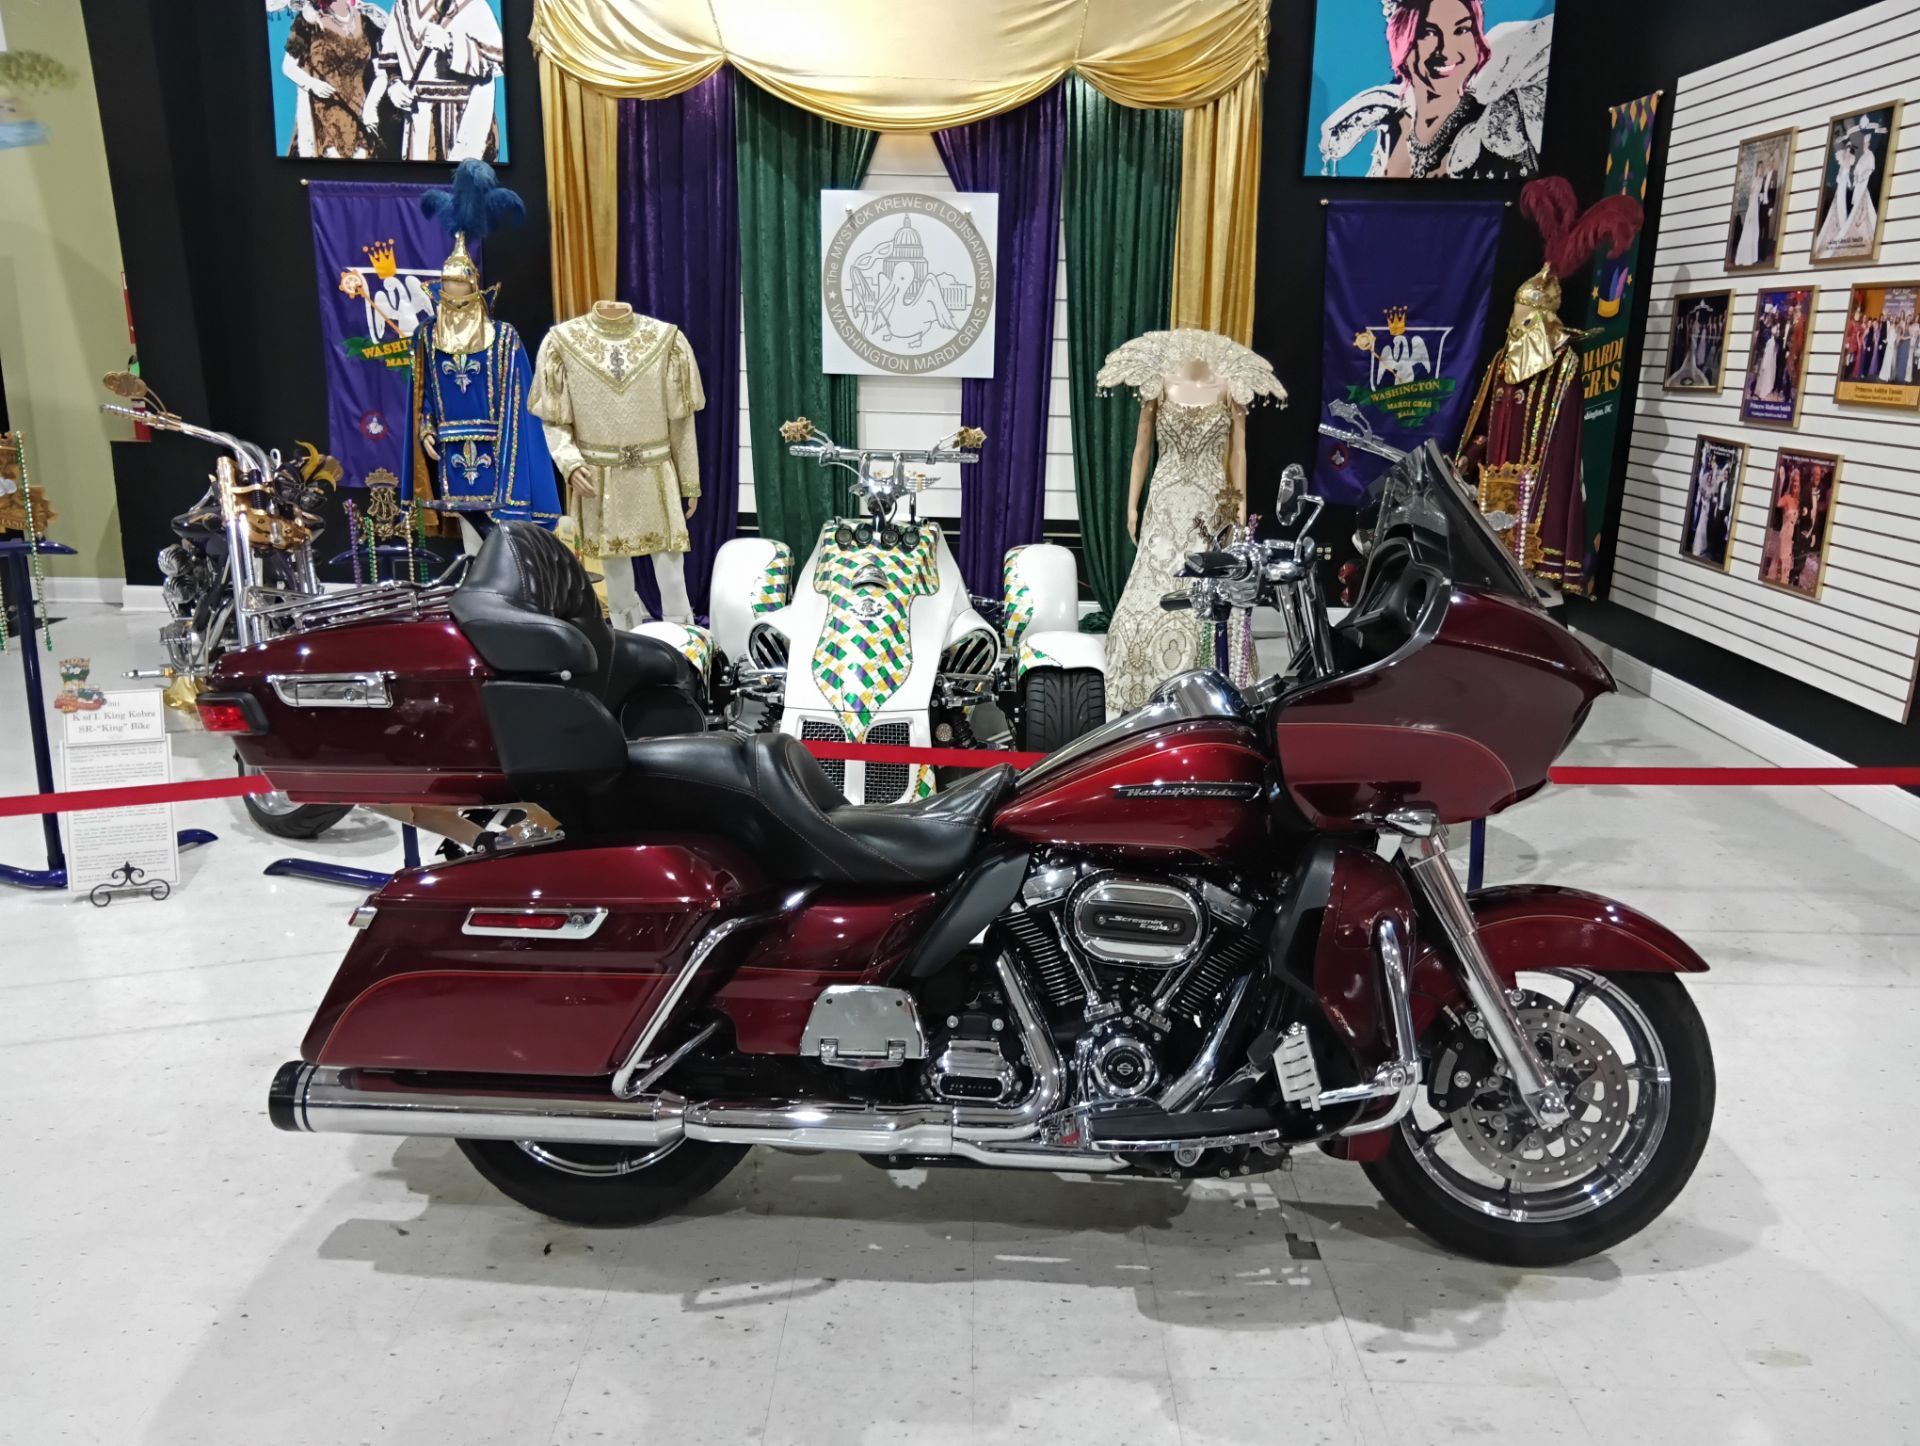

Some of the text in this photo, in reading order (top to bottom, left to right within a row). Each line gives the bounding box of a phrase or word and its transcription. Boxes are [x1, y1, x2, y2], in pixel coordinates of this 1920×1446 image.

[826, 196, 991, 290] The MYSTICK KREWE of LOUISIANIANS
[361, 339, 412, 359] WASHI
[829, 303, 987, 371] WASHINGTON MARDI GRAS
[1583, 337, 1625, 373] MARDI
[1369, 380, 1441, 401] WASHINGTON
[1386, 400, 1411, 410] MARDI
